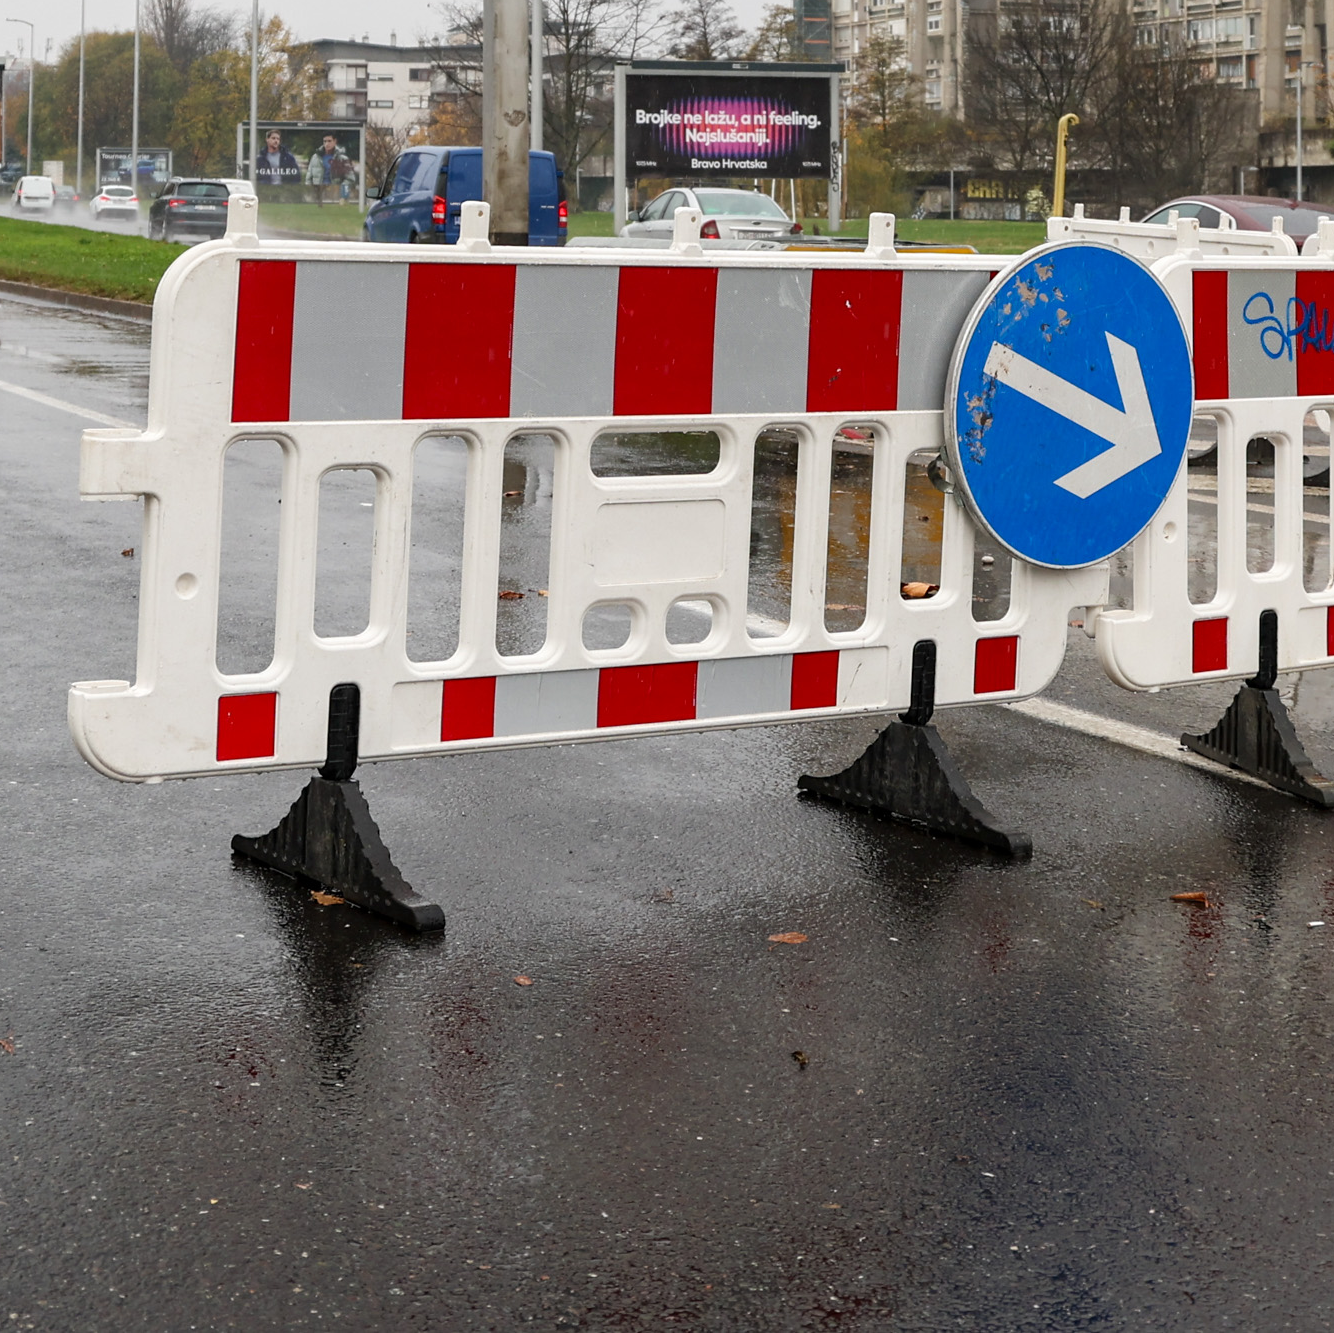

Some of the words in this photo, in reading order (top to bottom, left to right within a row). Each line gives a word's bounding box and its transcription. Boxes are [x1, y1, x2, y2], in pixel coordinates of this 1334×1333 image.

[635, 109, 682, 128] Brojke
[684, 113, 702, 125] ne
[704, 110, 739, 126] lažu,
[741, 114, 751, 125] a
[753, 111, 767, 125] ni
[769, 111, 822, 129] feeling.
[685, 128, 770, 146] Najslušaniji.
[691, 158, 721, 169] Bravo
[722, 158, 768, 170] Hrvatska
